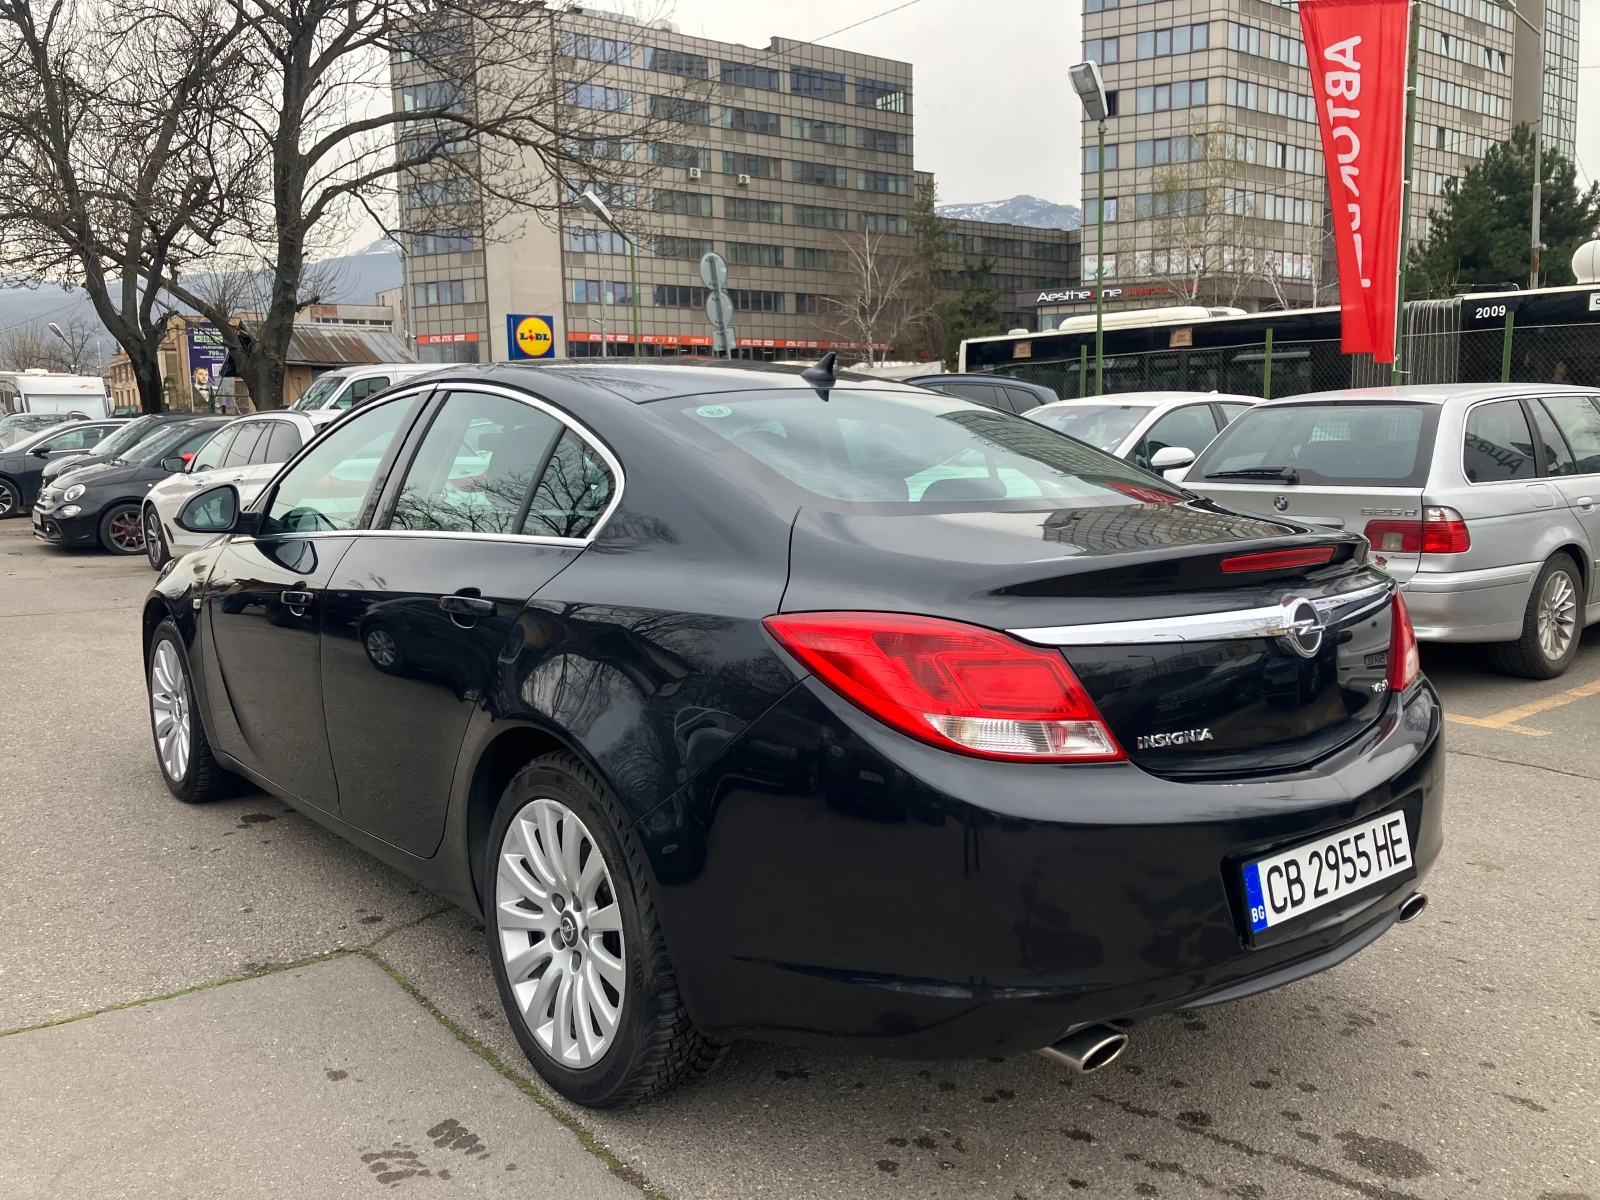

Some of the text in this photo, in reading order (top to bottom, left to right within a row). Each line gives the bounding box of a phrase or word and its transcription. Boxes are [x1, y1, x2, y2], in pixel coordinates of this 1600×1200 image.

[1037, 288, 1122, 303] AestheLne
[1475, 305, 1506, 319] 2009
[589, 333, 615, 341] ATHLTIC
[1361, 507, 1418, 517] 525d
[1137, 728, 1213, 750] INSIGNIA
[1266, 819, 1407, 914] CB 2955 HE
[1251, 905, 1265, 923] BG
